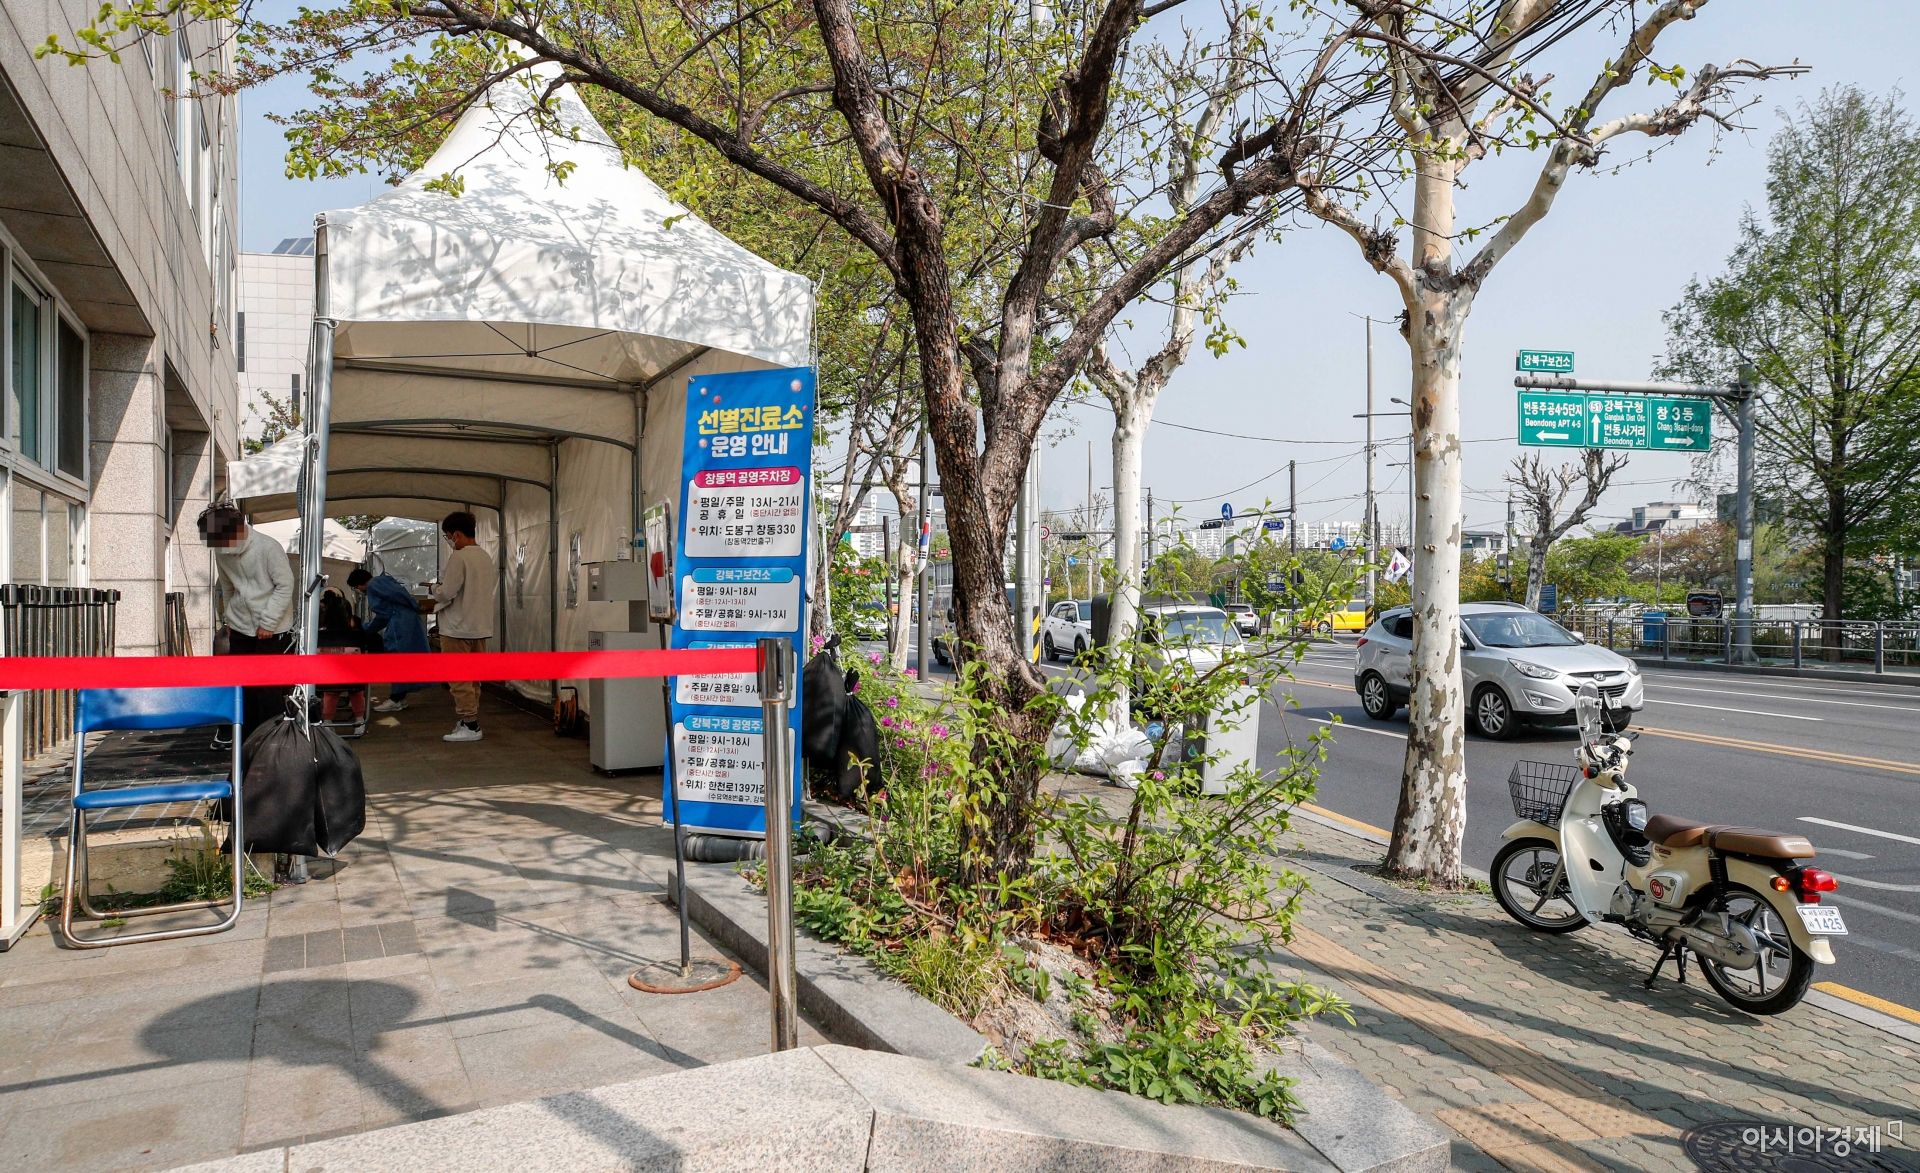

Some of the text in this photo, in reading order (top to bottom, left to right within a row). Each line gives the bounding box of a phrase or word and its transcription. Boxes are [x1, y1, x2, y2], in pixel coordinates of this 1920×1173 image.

[1524, 354, 1571, 368] 강북구보건소
[1604, 400, 1644, 414] 강북구청
[698, 404, 804, 435] 선별진료소
[1604, 412, 1625, 423] Gangbuk
[1671, 407, 1681, 421] 3
[1682, 407, 1694, 421] 동
[1525, 418, 1556, 430] Beondong
[1557, 419, 1570, 428] APT
[1656, 421, 1673, 433] Chang
[1603, 423, 1646, 438] 번동사거리
[711, 432, 789, 458] 운영 안내
[1603, 436, 1645, 447] Beondong Jct
[705, 470, 791, 485] 창동역 공영주차장
[700, 496, 799, 508] 평일/주말 13시~21시
[698, 524, 796, 536] 위치: 도봉구 창동330
[715, 569, 772, 581] 강북구보건소
[697, 586, 718, 597] 평일:
[695, 608, 747, 619] 주말/공휴일:
[691, 682, 743, 693] 주말/공휴일:
[692, 717, 764, 732] 강북구청 공영주
[688, 734, 710, 745] 평일:
[687, 757, 740, 769] 주말/공휴일:
[685, 779, 707, 790] 위치:
